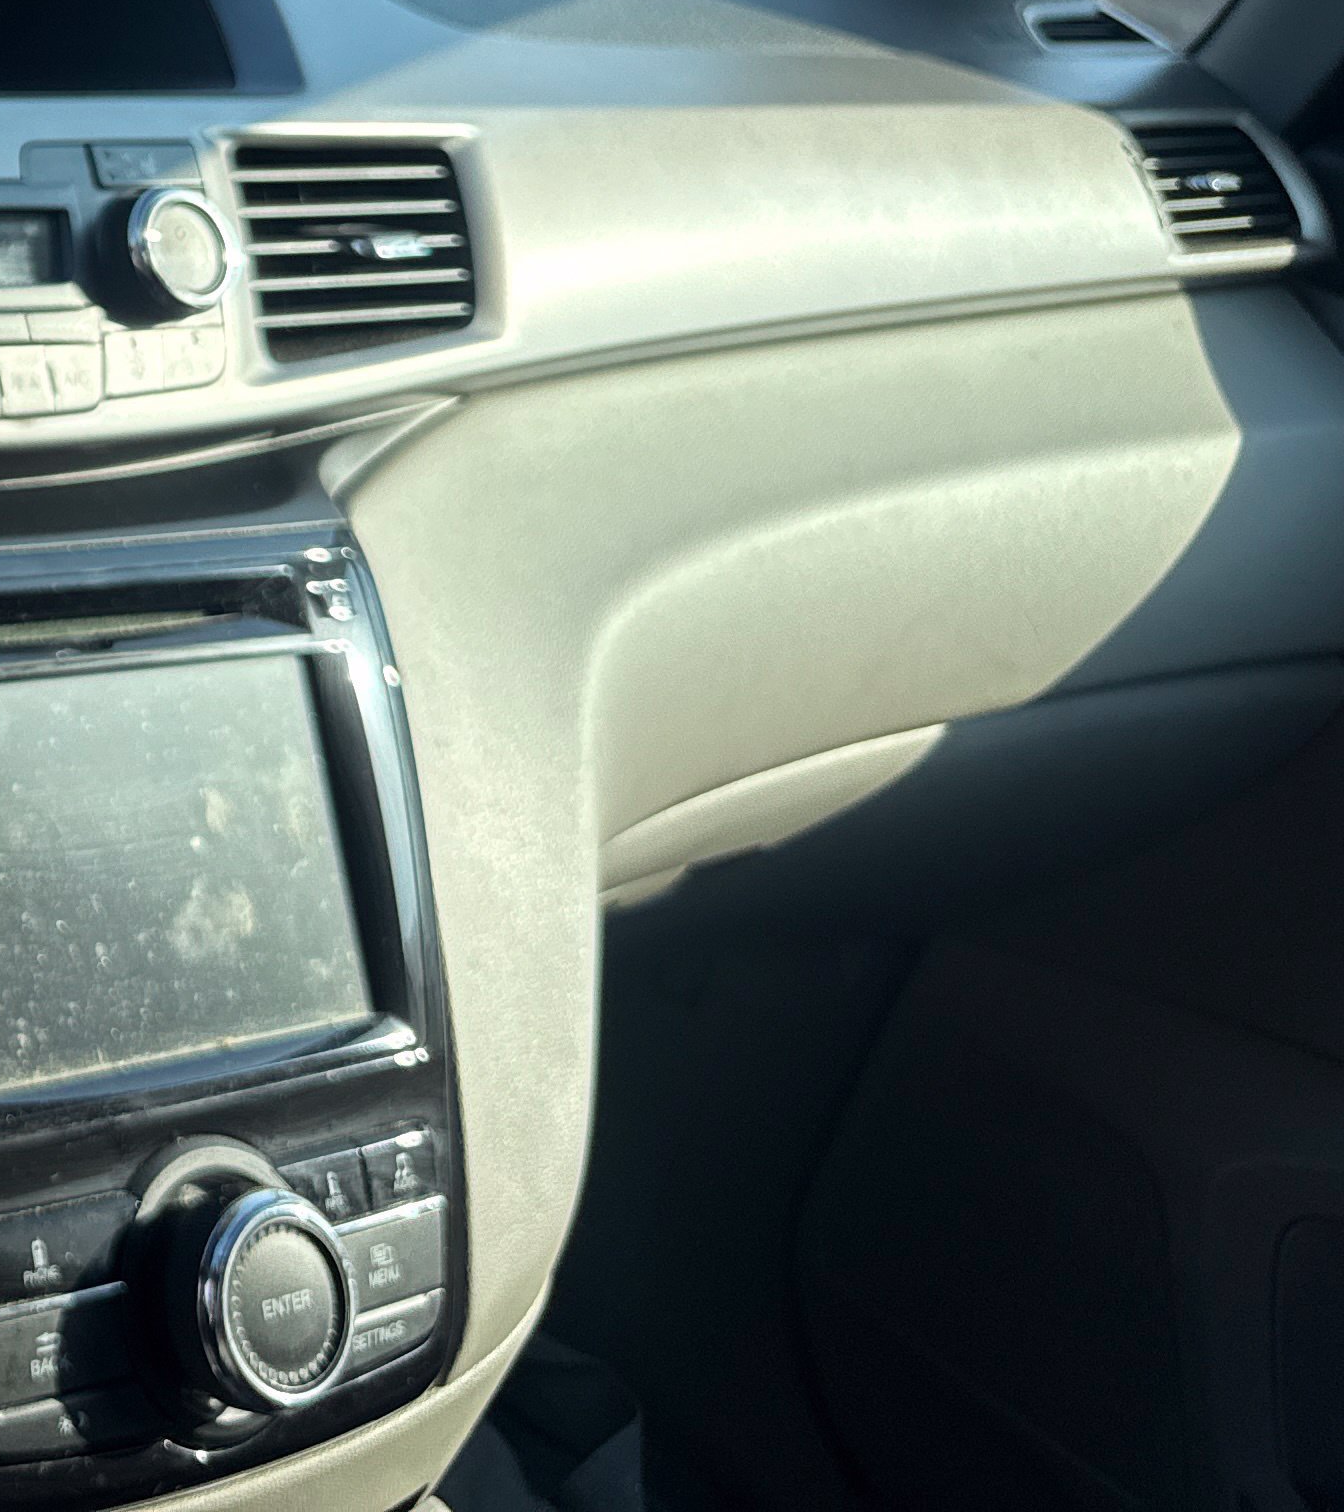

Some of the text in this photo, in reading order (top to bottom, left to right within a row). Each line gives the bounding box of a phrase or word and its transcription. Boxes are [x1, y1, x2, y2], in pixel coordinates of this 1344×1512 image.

[368, 1263, 401, 1289] MENU
[261, 1288, 314, 1321] ENTER
[352, 1319, 408, 1352] SETTINGS
